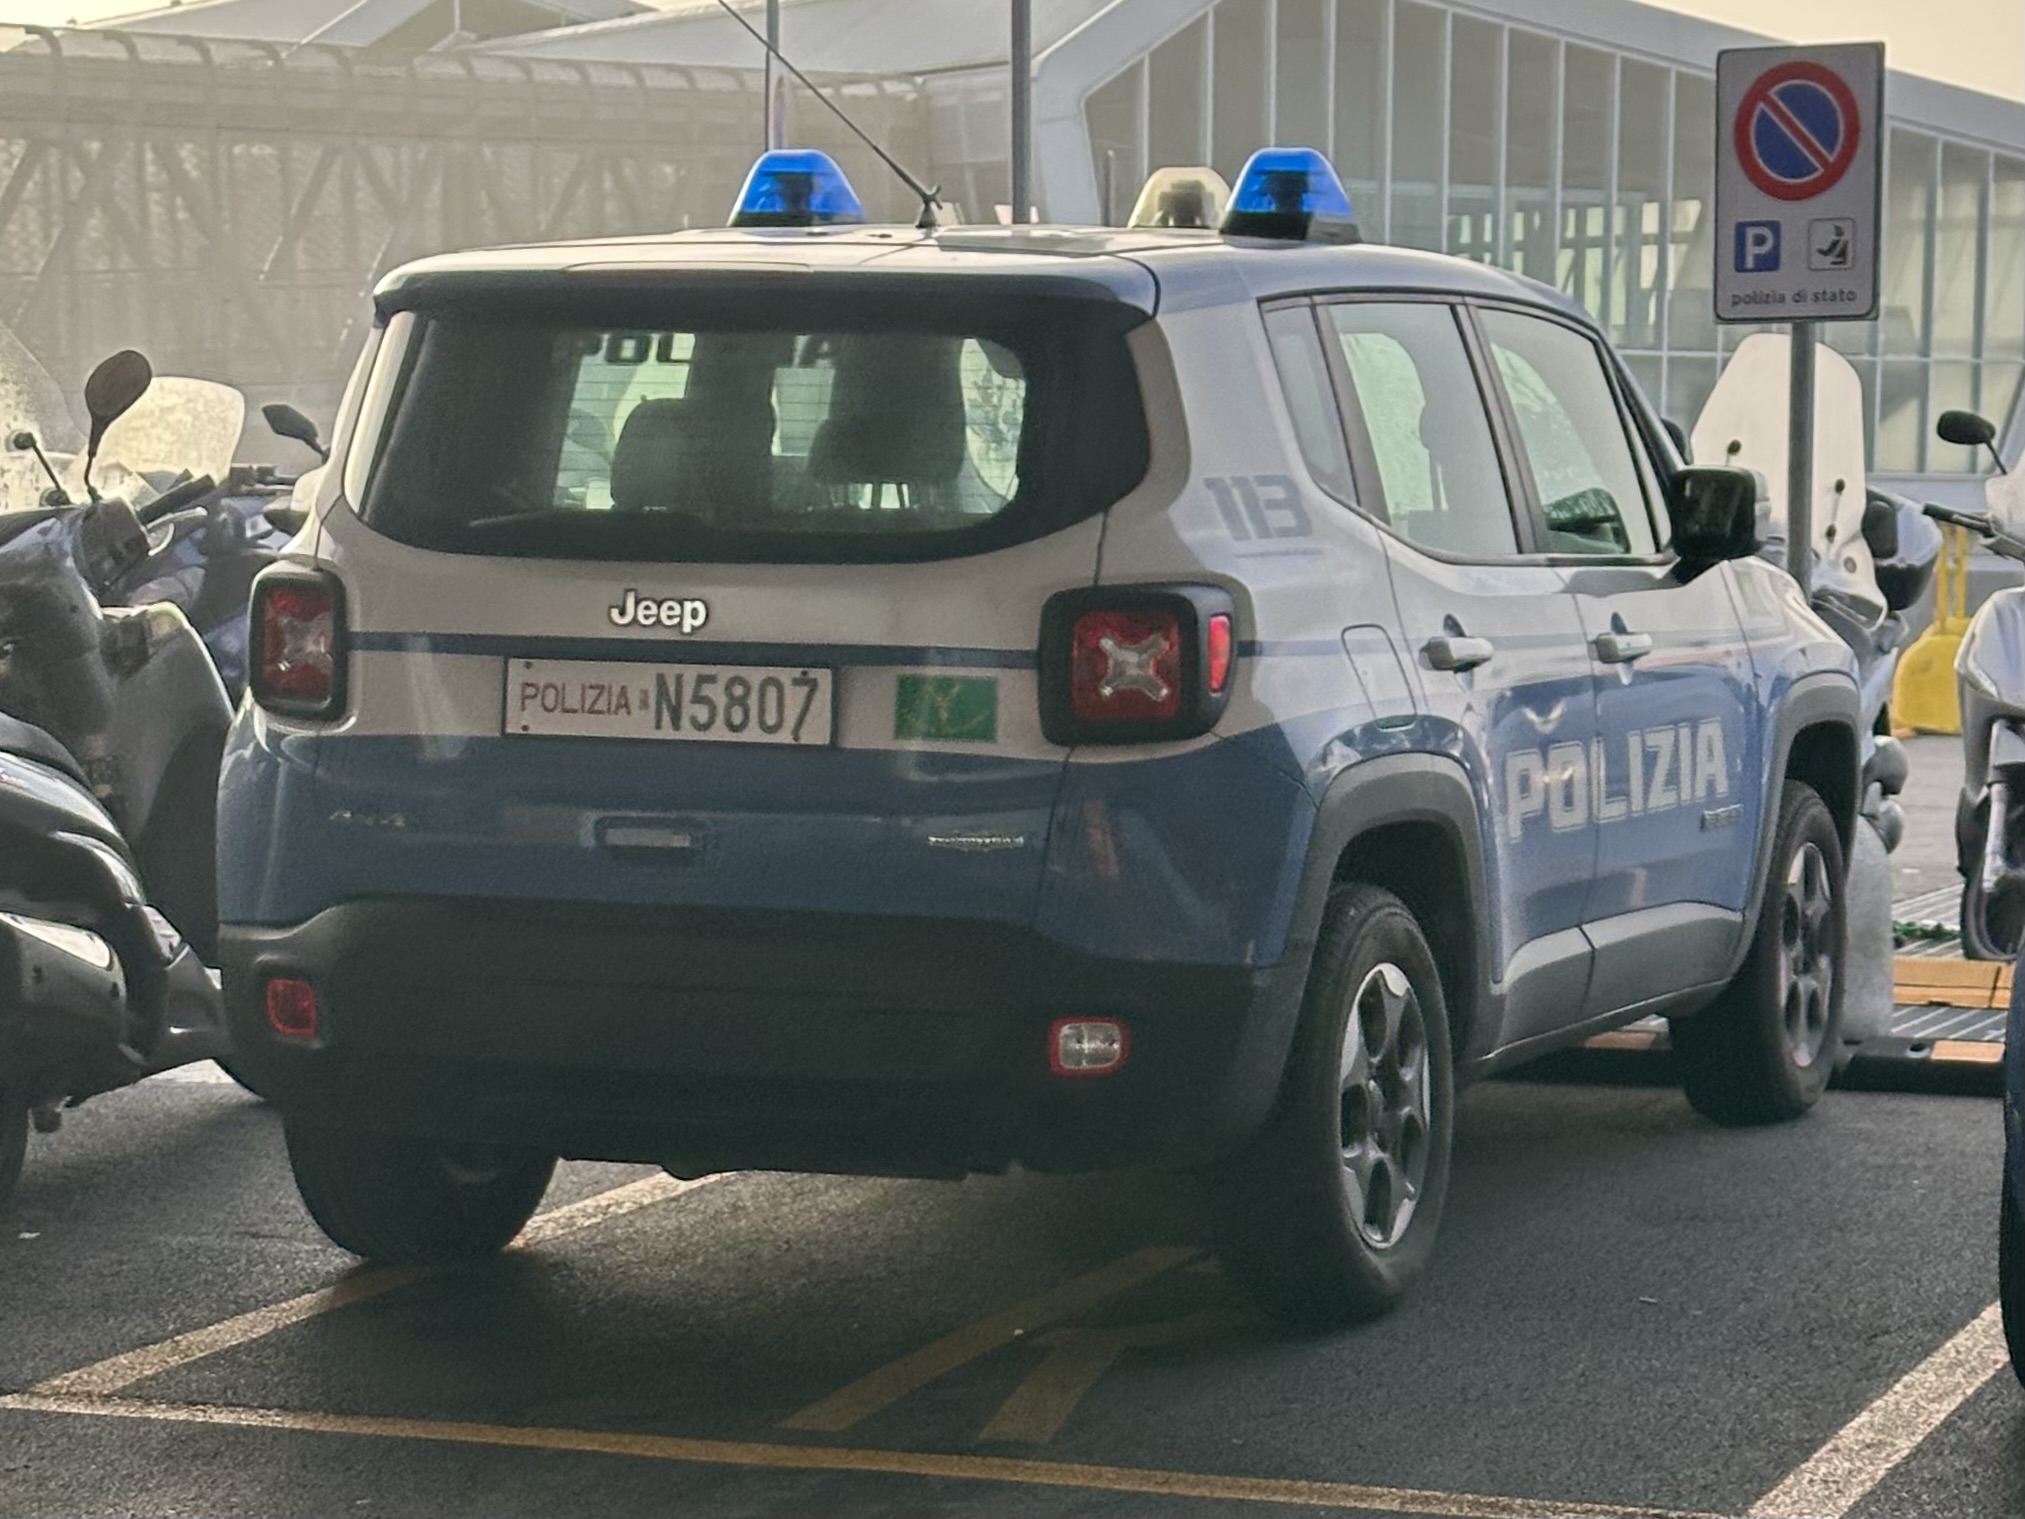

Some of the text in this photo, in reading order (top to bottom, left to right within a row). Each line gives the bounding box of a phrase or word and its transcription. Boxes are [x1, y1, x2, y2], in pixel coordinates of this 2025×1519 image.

[1745, 226, 1774, 269] P
[1731, 288, 1857, 307] polizia di stato
[1203, 474, 1313, 541] 113
[608, 588, 709, 635] Jeep
[520, 672, 819, 738] POLIZIA N5807
[1505, 716, 1729, 845] POLIZIA
